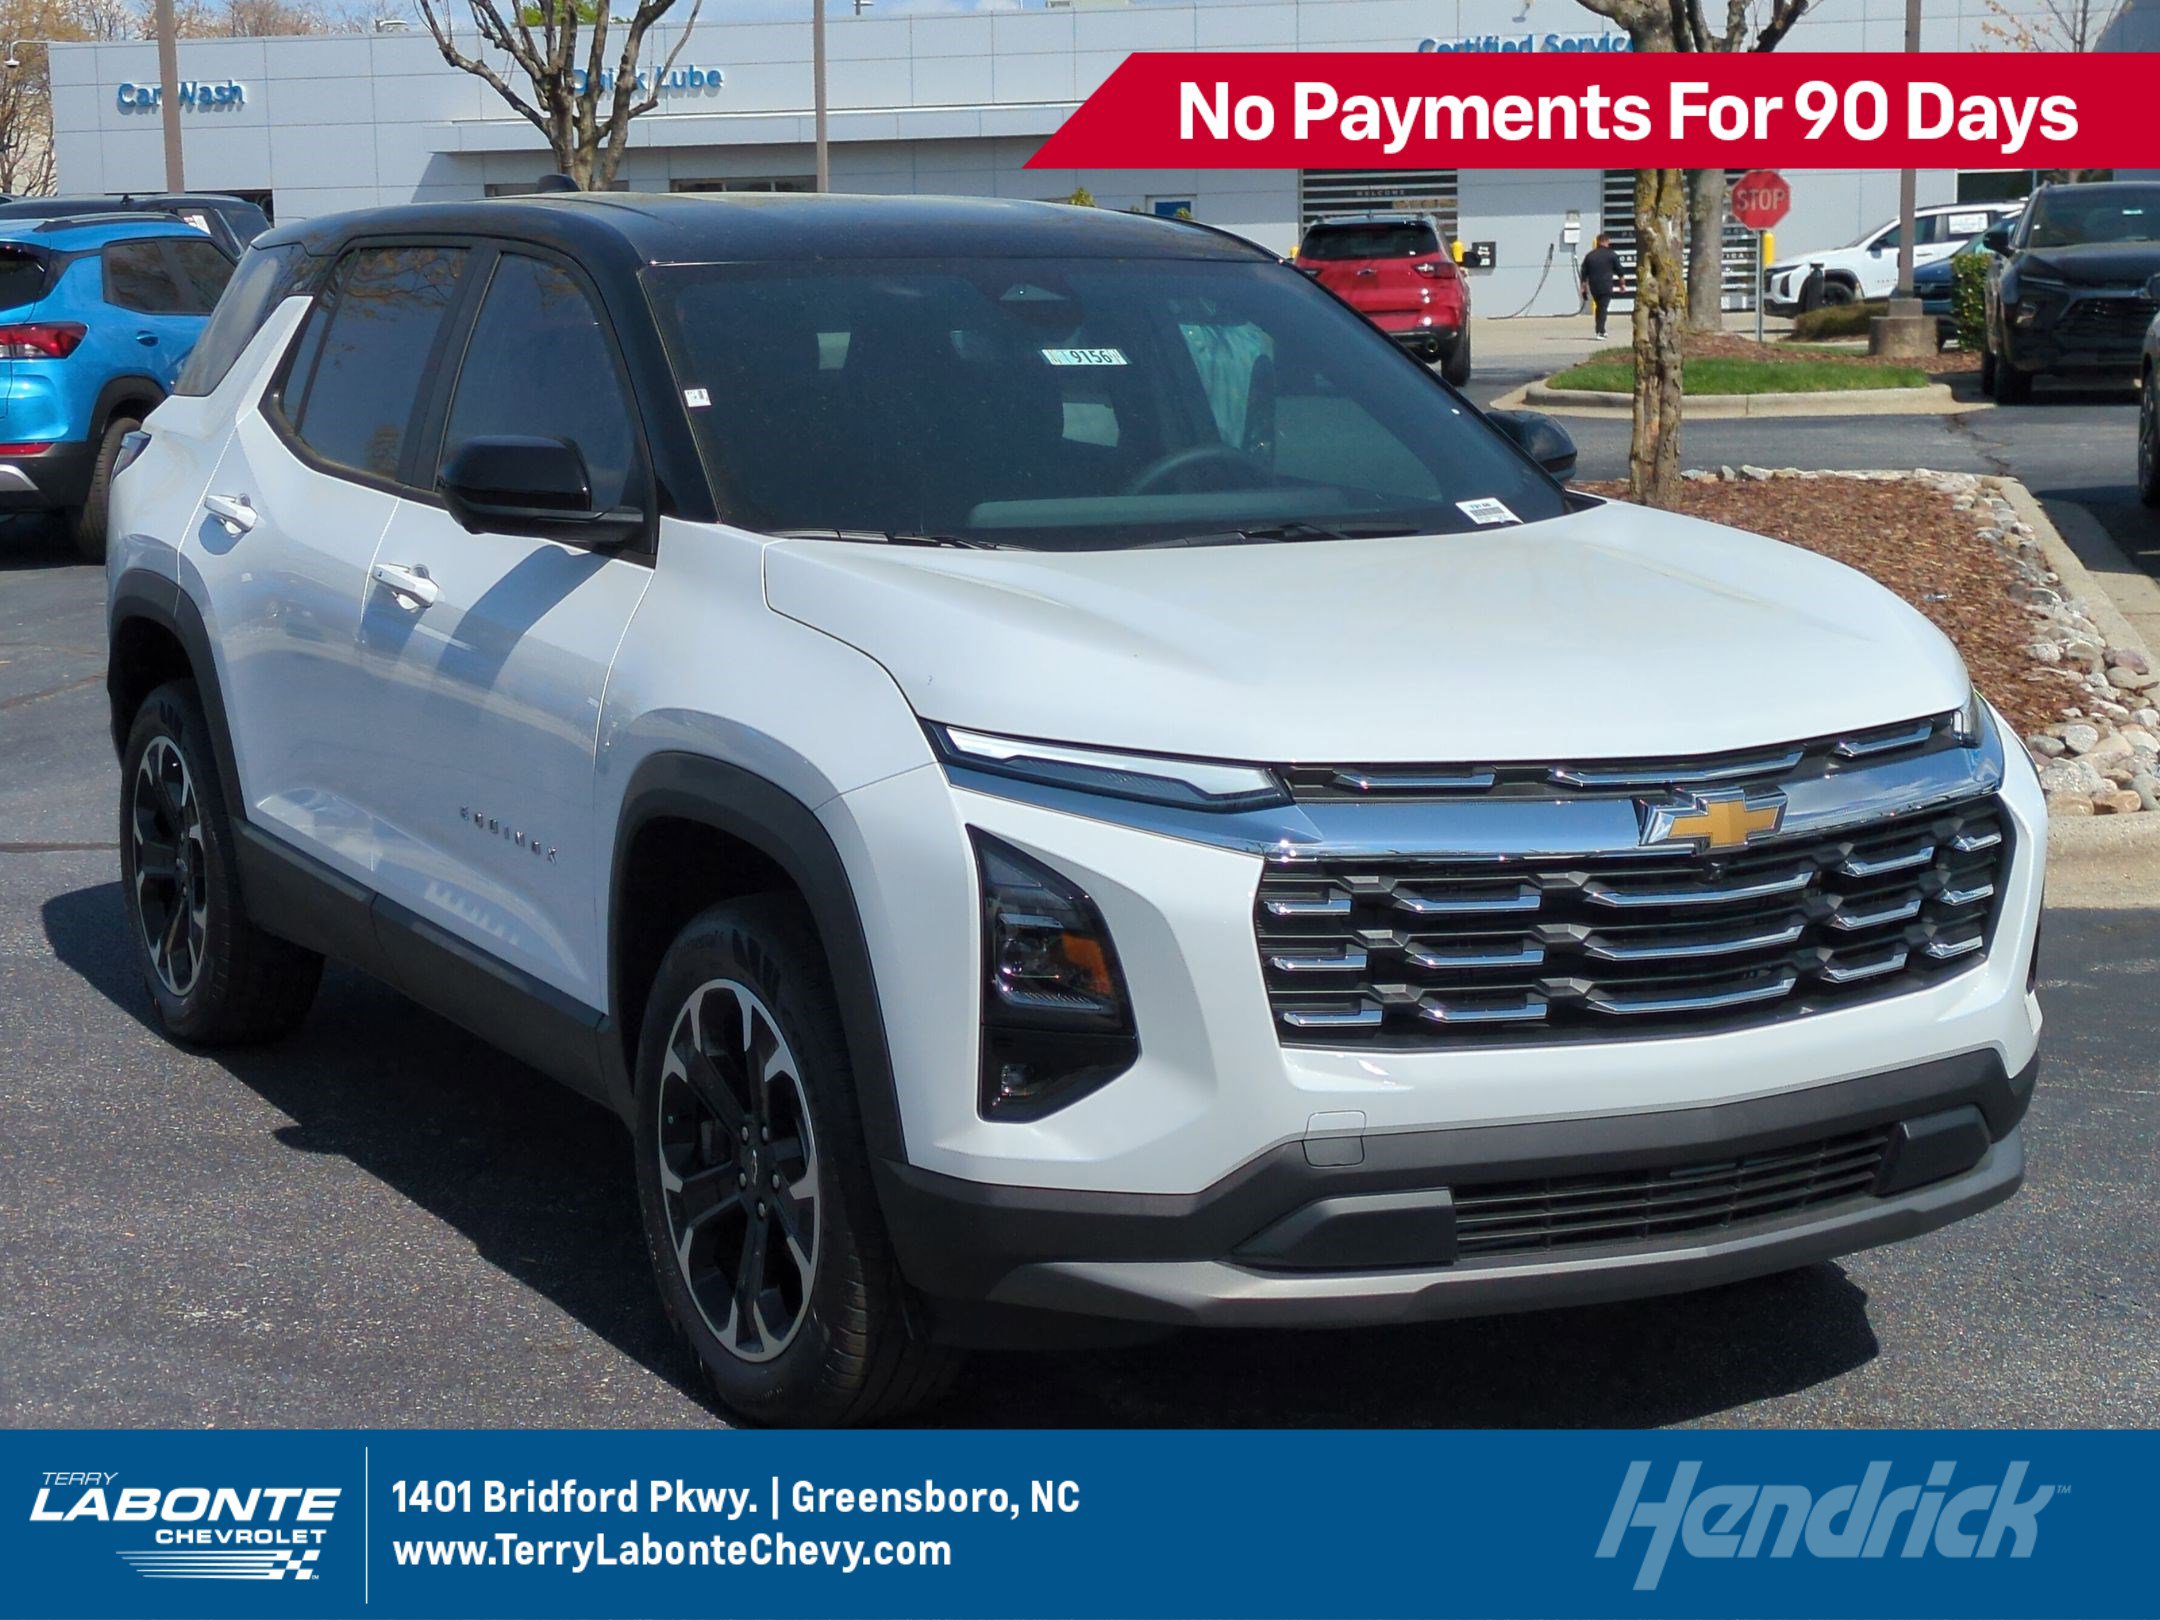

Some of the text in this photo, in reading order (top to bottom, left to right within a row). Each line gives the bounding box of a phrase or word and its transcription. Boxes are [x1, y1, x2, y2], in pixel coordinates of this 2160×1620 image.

[1418, 34, 1533, 53] Certified
[656, 64, 723, 89] Lube
[118, 79, 244, 107] Car Wash
[1737, 188, 1785, 211] STOP
